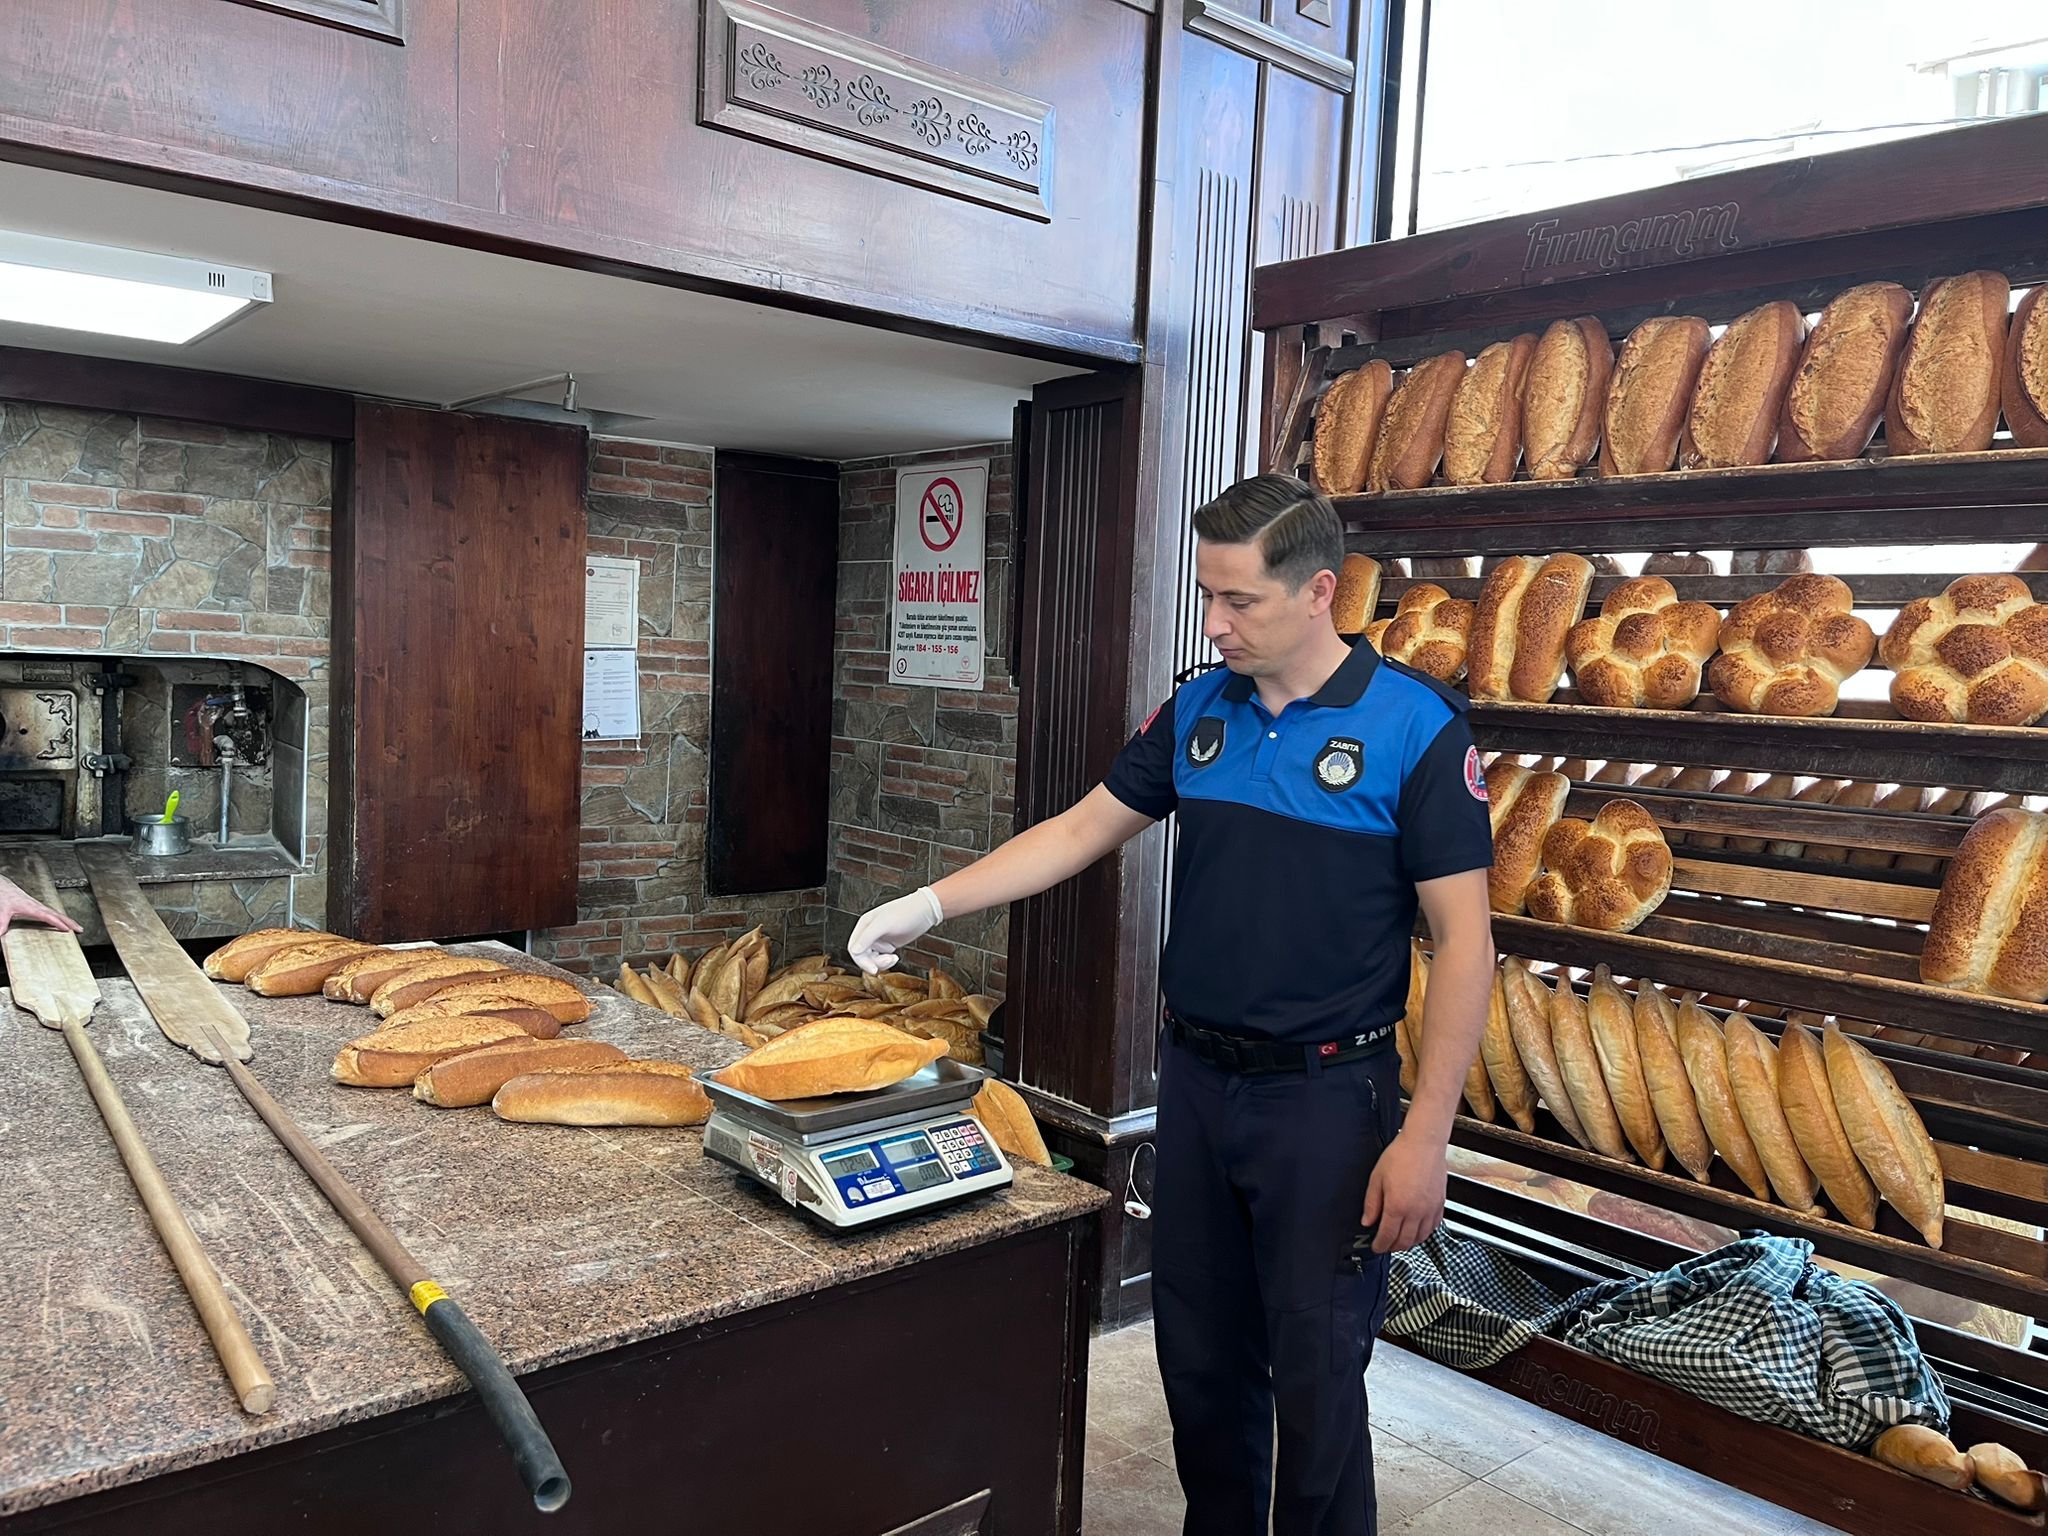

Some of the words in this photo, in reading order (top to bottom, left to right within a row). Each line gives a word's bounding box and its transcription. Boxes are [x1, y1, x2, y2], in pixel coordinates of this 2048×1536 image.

[899, 564, 934, 602] SİGARA
[937, 563, 979, 607] İÇİLMEZ
[916, 643, 927, 652] 184
[932, 644, 943, 653] 155
[947, 645, 959, 654] 156
[1329, 740, 1359, 753] ZABITA
[1506, 1357, 1661, 1451] ıncımm
